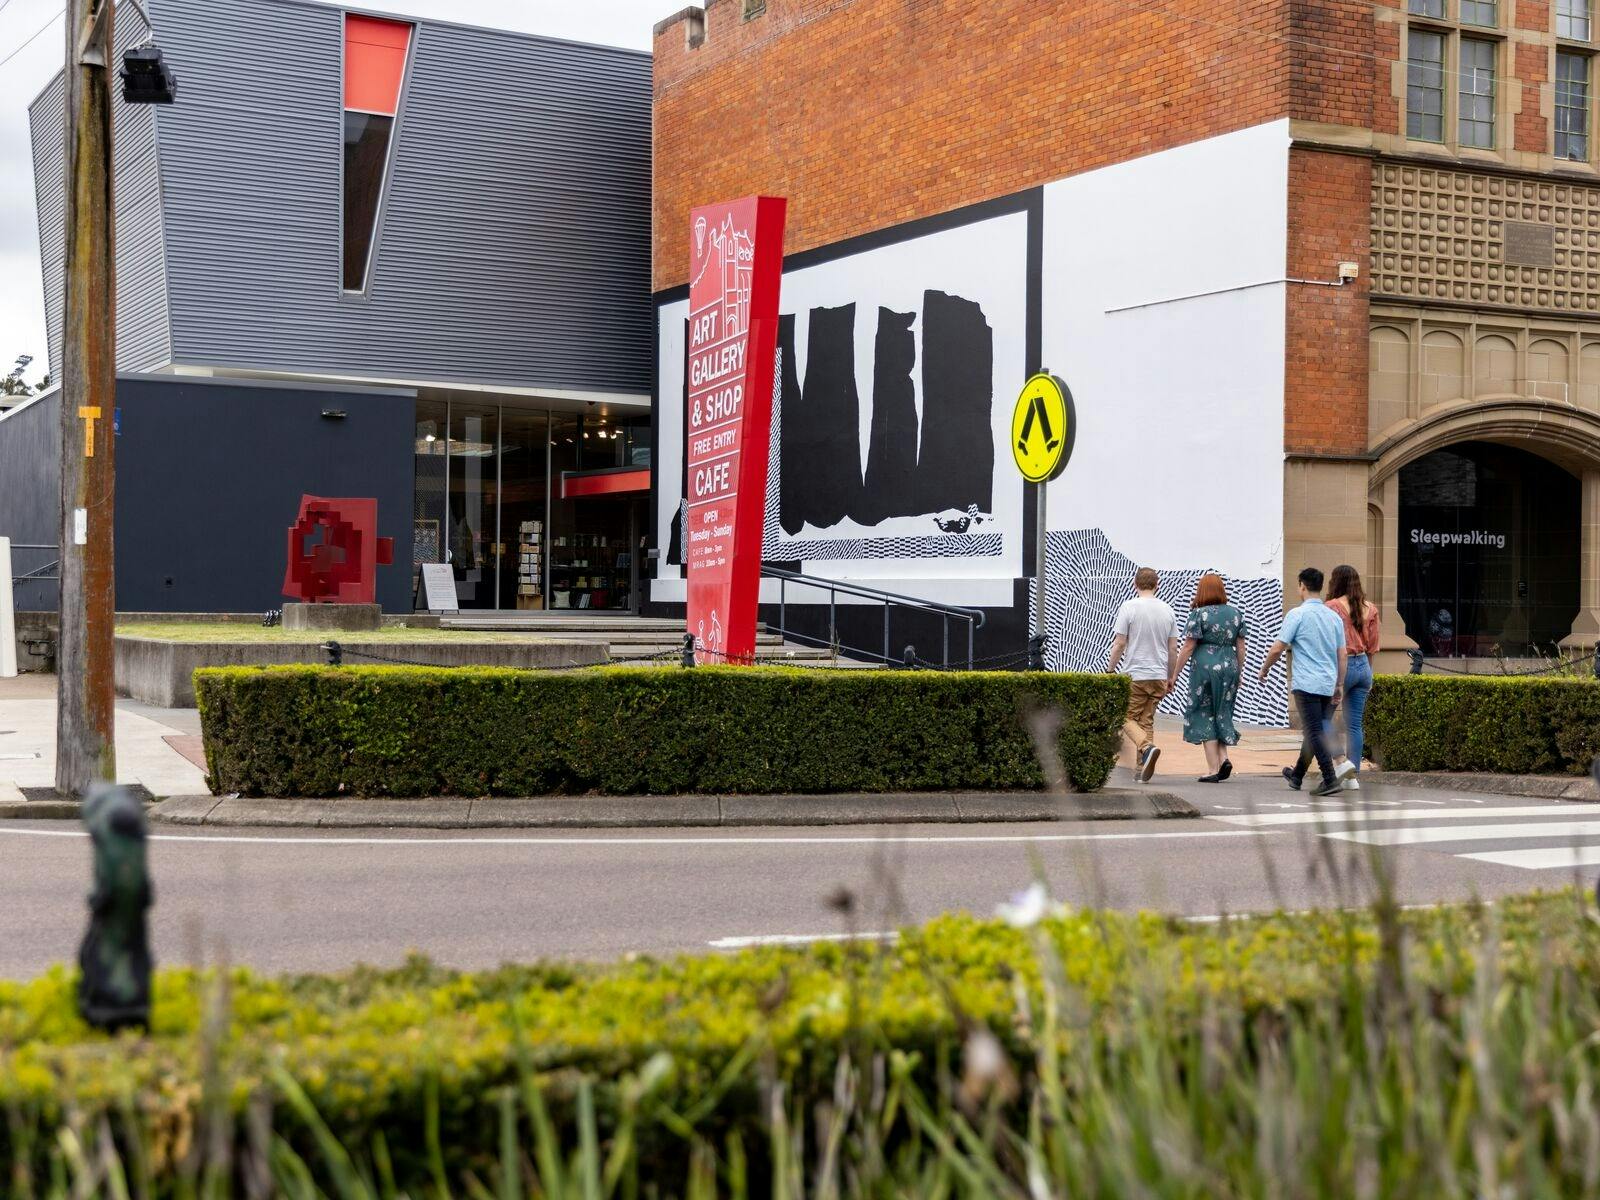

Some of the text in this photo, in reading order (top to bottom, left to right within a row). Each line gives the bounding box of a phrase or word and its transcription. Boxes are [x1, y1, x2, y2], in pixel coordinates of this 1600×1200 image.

[692, 311, 718, 347] ART
[691, 339, 746, 387] GALLERY
[692, 385, 742, 427] & SHOP
[693, 428, 736, 456] FREE ENTRY
[695, 461, 730, 497] CAFE
[690, 529, 710, 541] Tuesday
[714, 524, 732, 537] Sunday
[703, 510, 718, 524] OPEN
[1410, 528, 1505, 549] Sleepwalking
